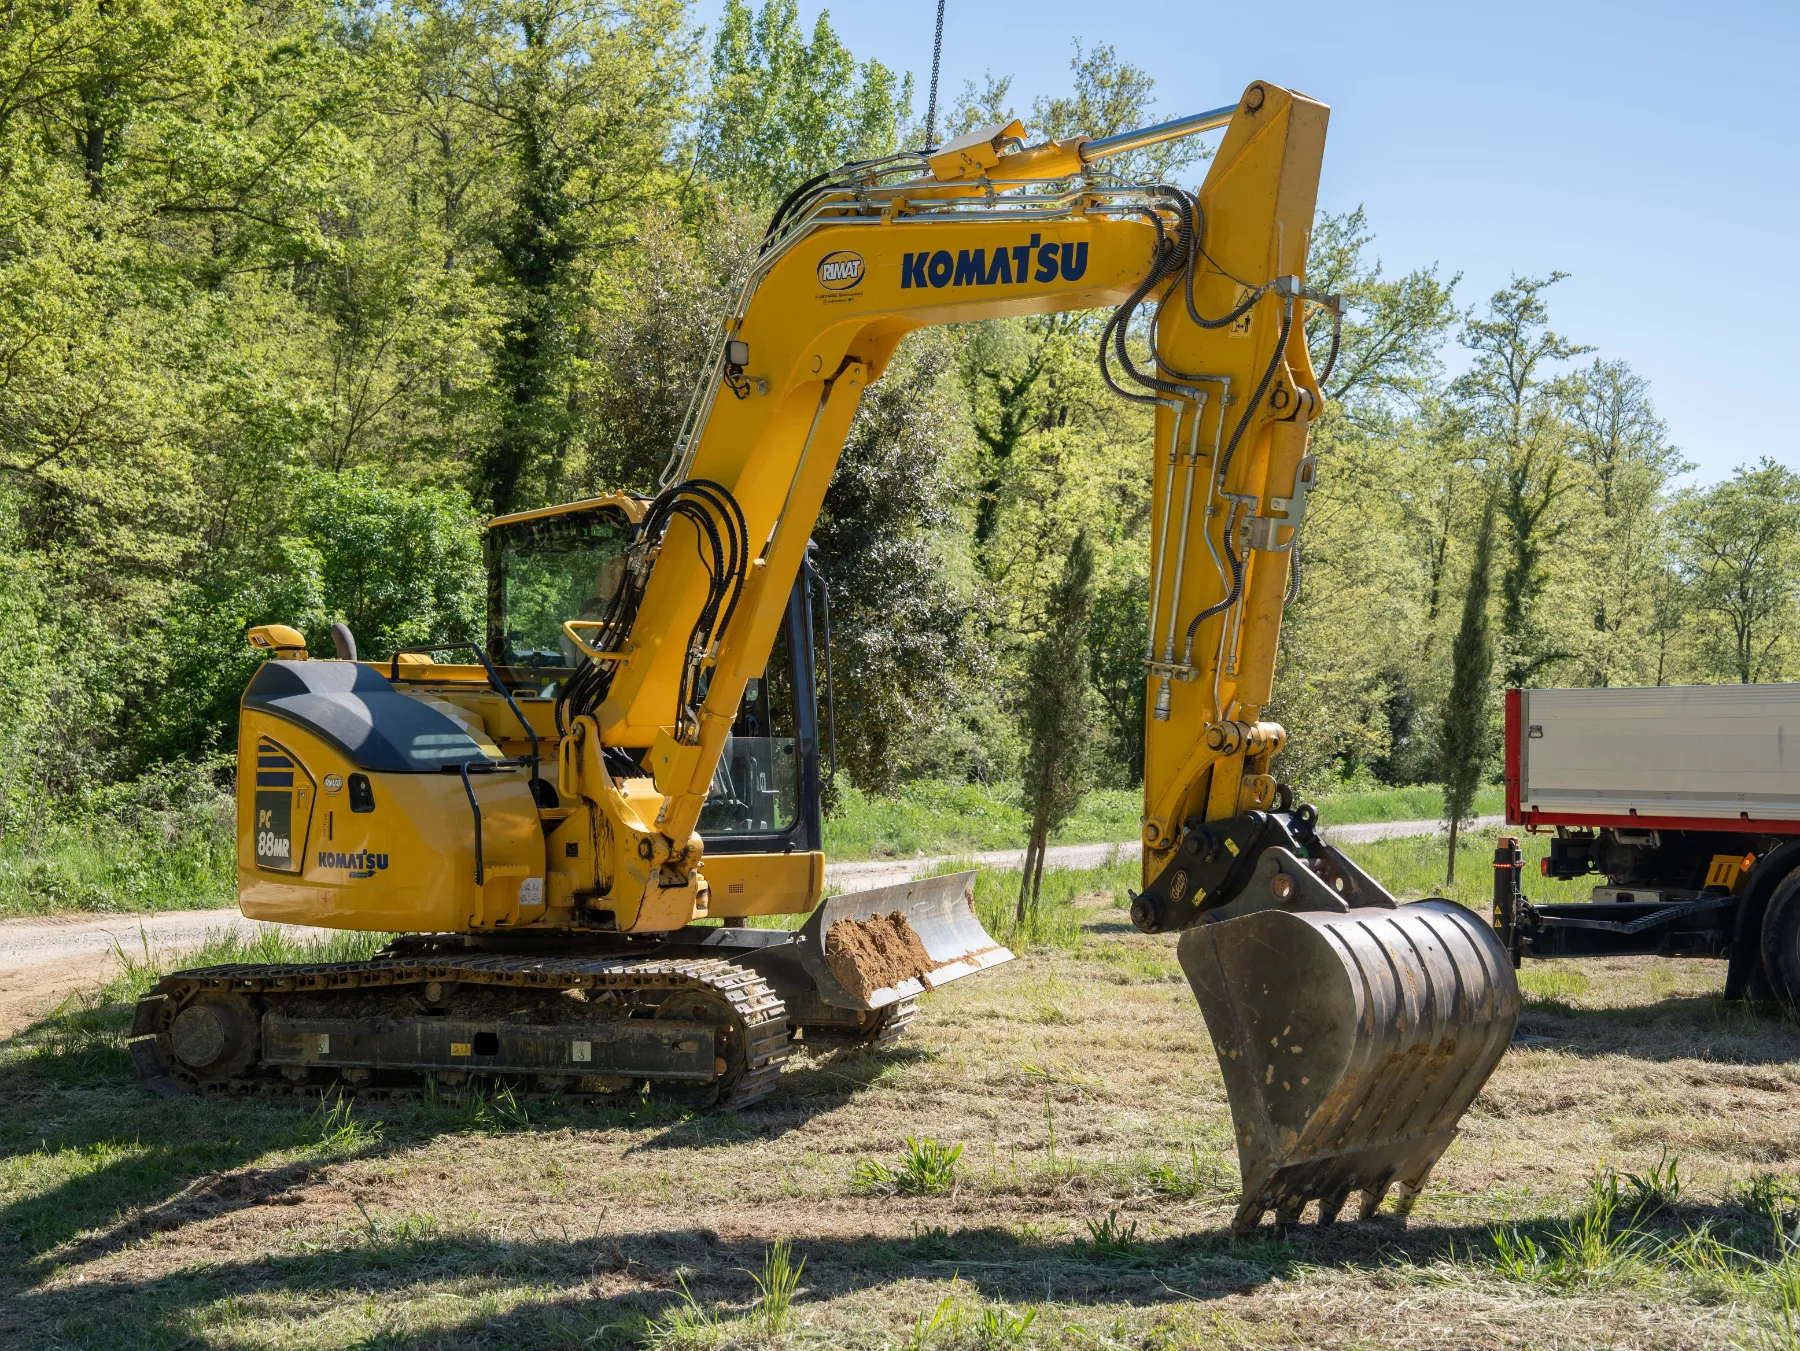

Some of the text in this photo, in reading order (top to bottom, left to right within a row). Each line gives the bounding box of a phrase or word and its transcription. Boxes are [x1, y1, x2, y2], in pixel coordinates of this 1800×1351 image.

[822, 259, 861, 281] RIMAT
[901, 233, 1089, 289] KOMATSU
[325, 778, 342, 788] RIMAT
[258, 809, 272, 829] PC
[257, 831, 290, 858] 88MR
[318, 849, 389, 870] KOMATSU
